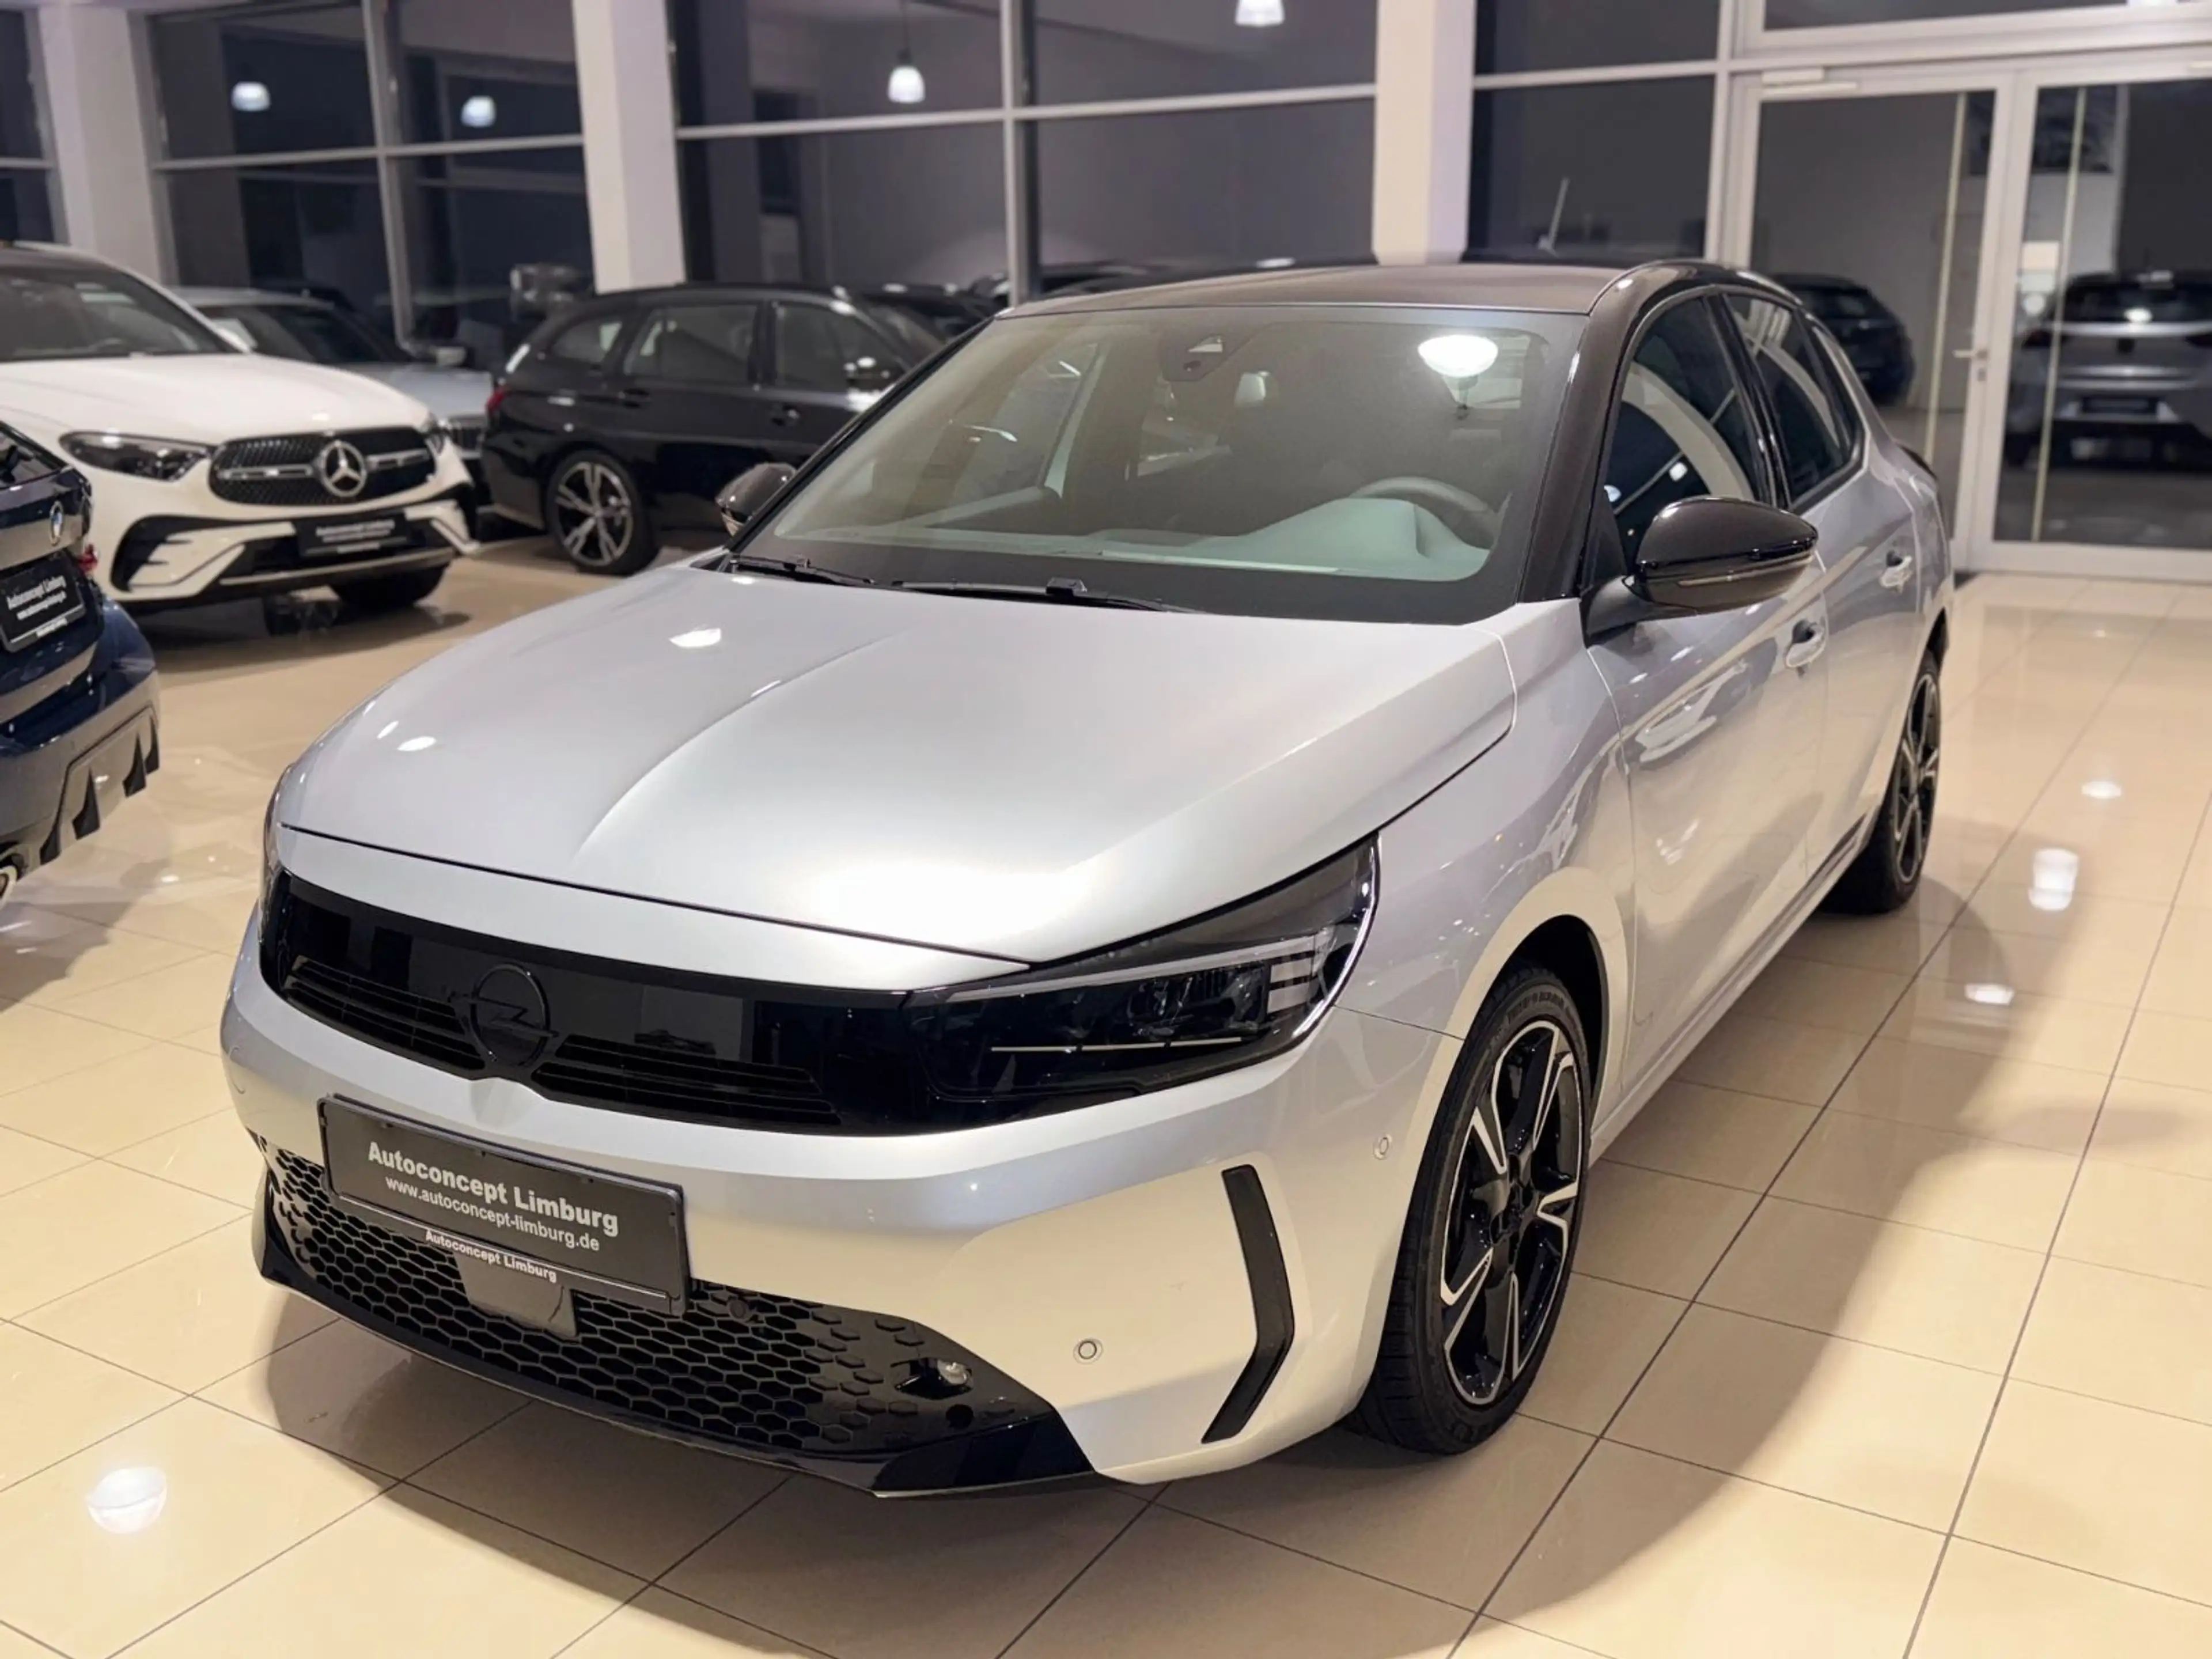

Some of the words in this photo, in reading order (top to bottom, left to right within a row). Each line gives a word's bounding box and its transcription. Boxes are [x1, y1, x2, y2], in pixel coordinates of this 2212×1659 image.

[368, 1141, 508, 1204] Autoconcept
[513, 1186, 619, 1237] Limburg
[385, 1176, 600, 1251] www.autoconcept-limburg.de
[426, 1230, 501, 1265] Autoconcept
[503, 1255, 557, 1283] Limburg
